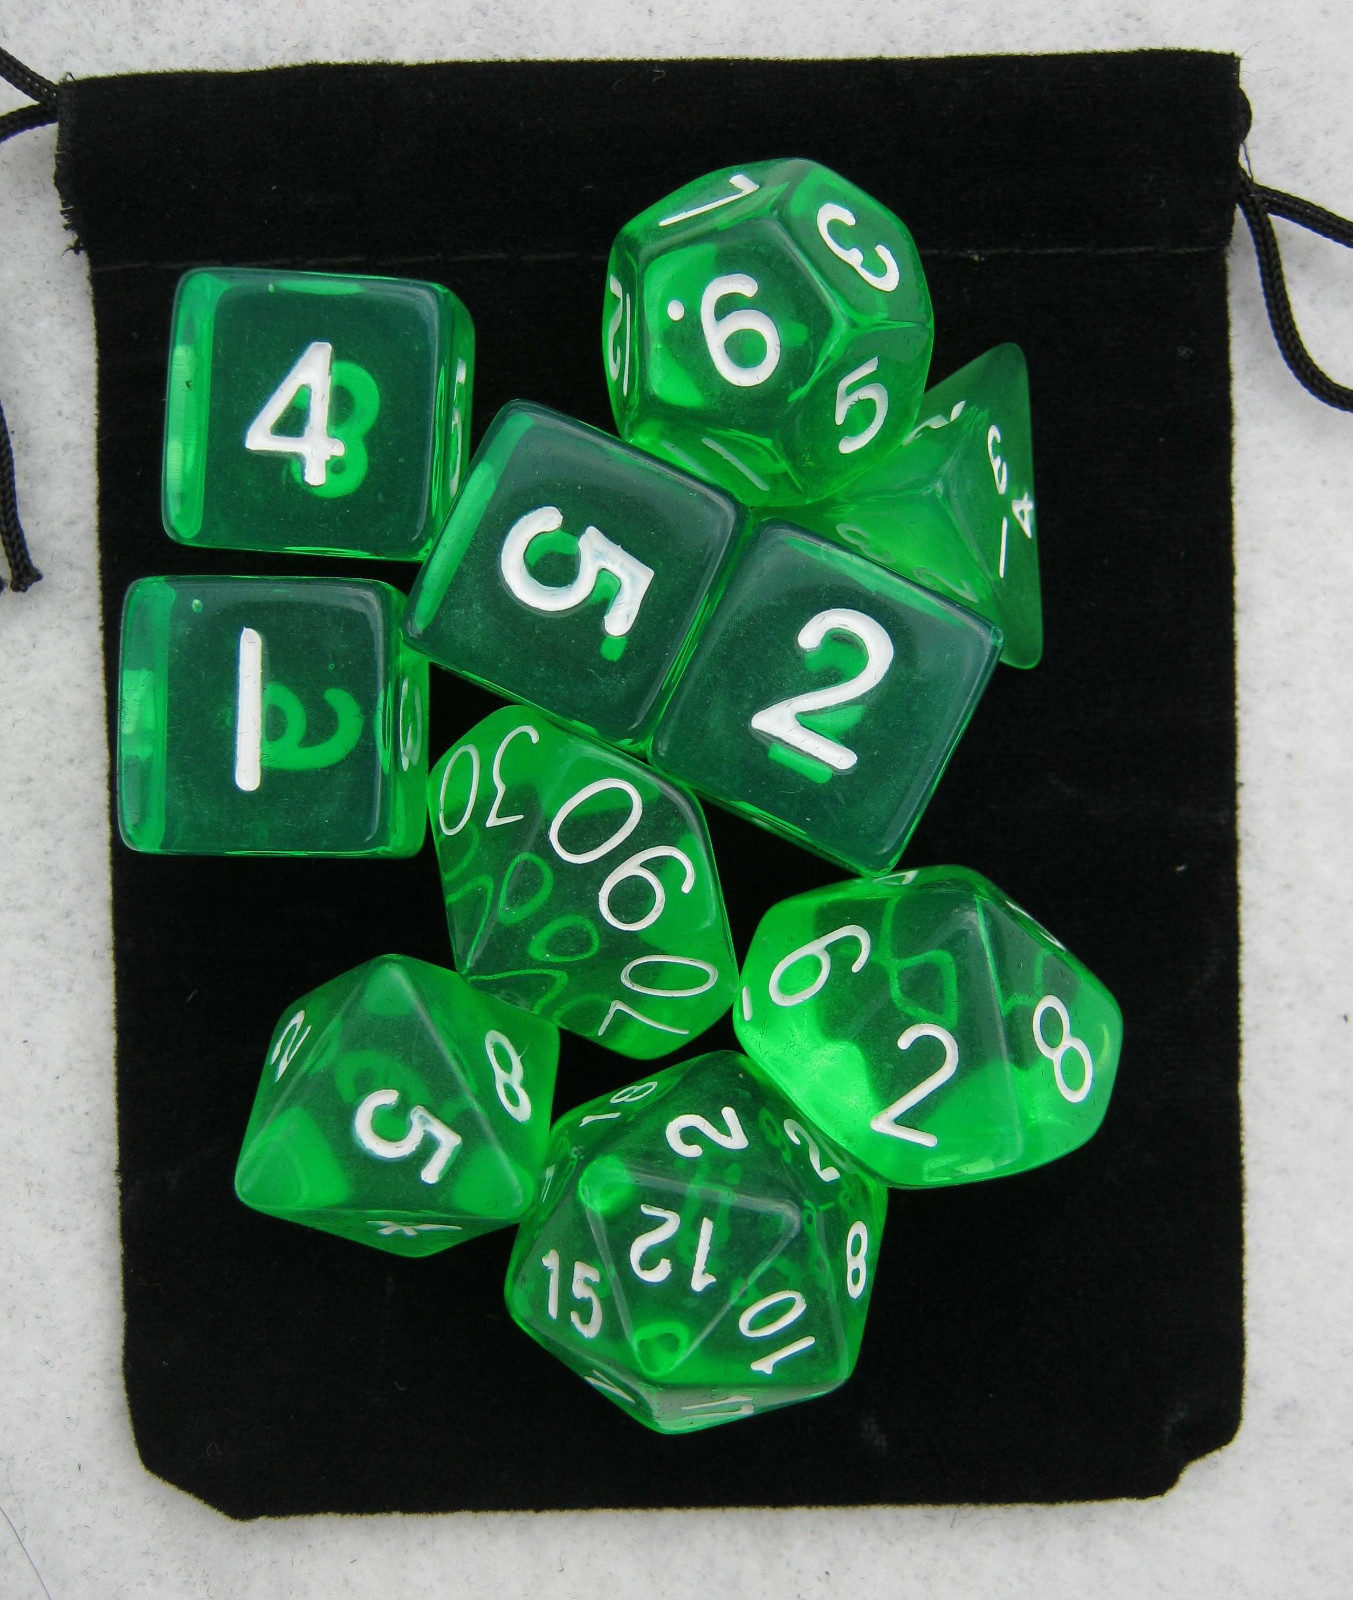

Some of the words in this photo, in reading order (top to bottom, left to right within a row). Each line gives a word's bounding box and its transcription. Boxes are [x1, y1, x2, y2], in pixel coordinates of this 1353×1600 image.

[817, 203, 900, 292] 3
[245, 342, 345, 486] 4
[835, 356, 889, 454] 5
[500, 506, 654, 637] 5
[235, 627, 262, 792] 1
[751, 608, 894, 770] 2
[485, 1030, 531, 1123] 8
[869, 1023, 960, 1147] 2
[1033, 995, 1093, 1104] 8
[354, 1089, 462, 1184] 5
[666, 1106, 749, 1158] 2
[542, 1249, 603, 1338] 15
[630, 1204, 716, 1292] 12
[846, 1221, 868, 1299] 8
[739, 1290, 815, 1374] 10
